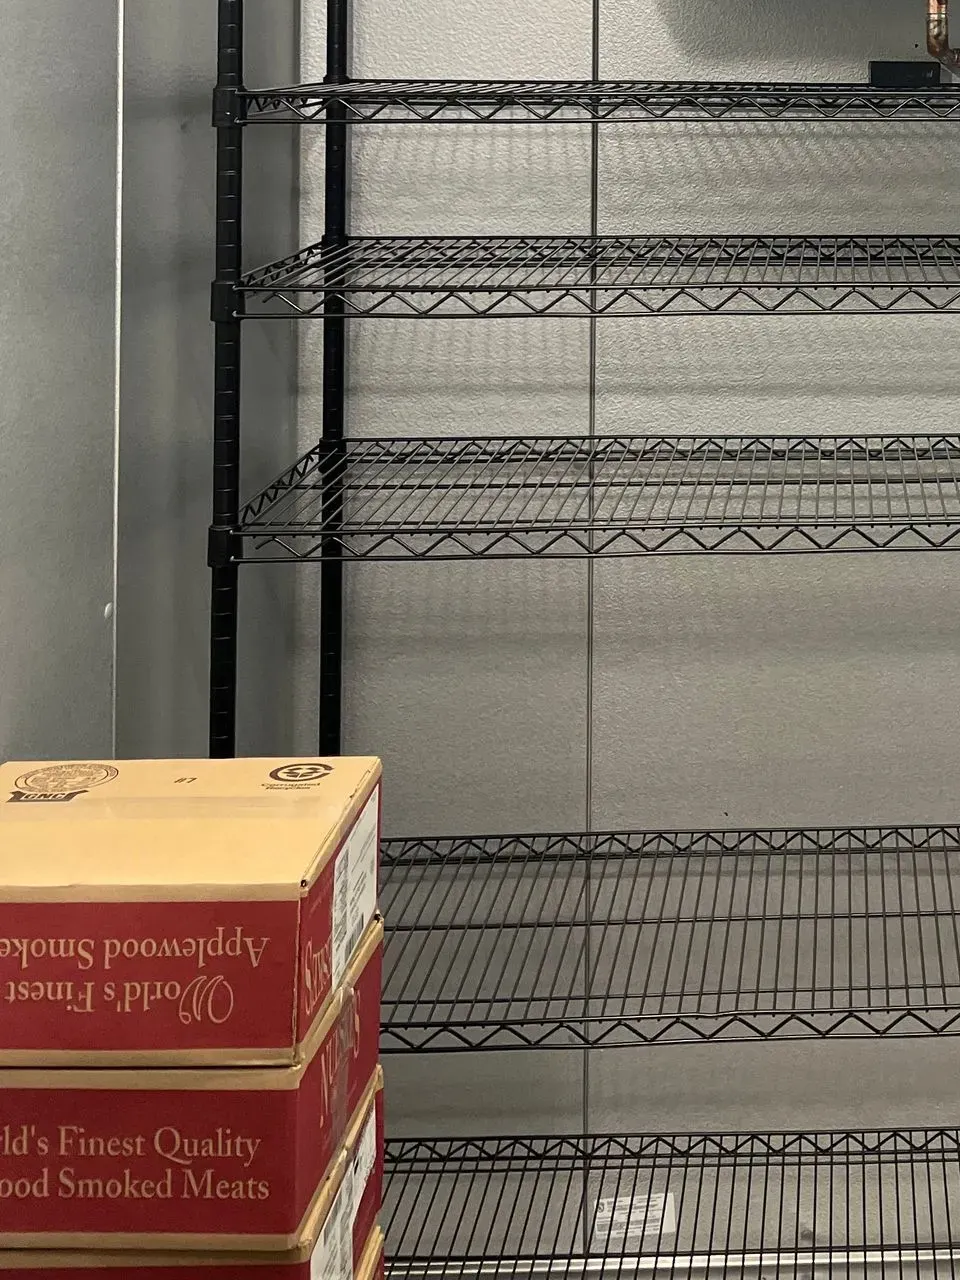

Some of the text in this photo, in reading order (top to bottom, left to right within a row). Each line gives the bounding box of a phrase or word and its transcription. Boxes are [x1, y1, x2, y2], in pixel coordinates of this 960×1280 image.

[0, 927, 270, 970] Applewood Smoke
[5, 975, 234, 1024] World's Finest
[58, 1125, 146, 1156] Finest
[154, 1126, 261, 1167] Quality
[58, 1167, 172, 1199] Smoked
[182, 1169, 270, 1199] Meats
